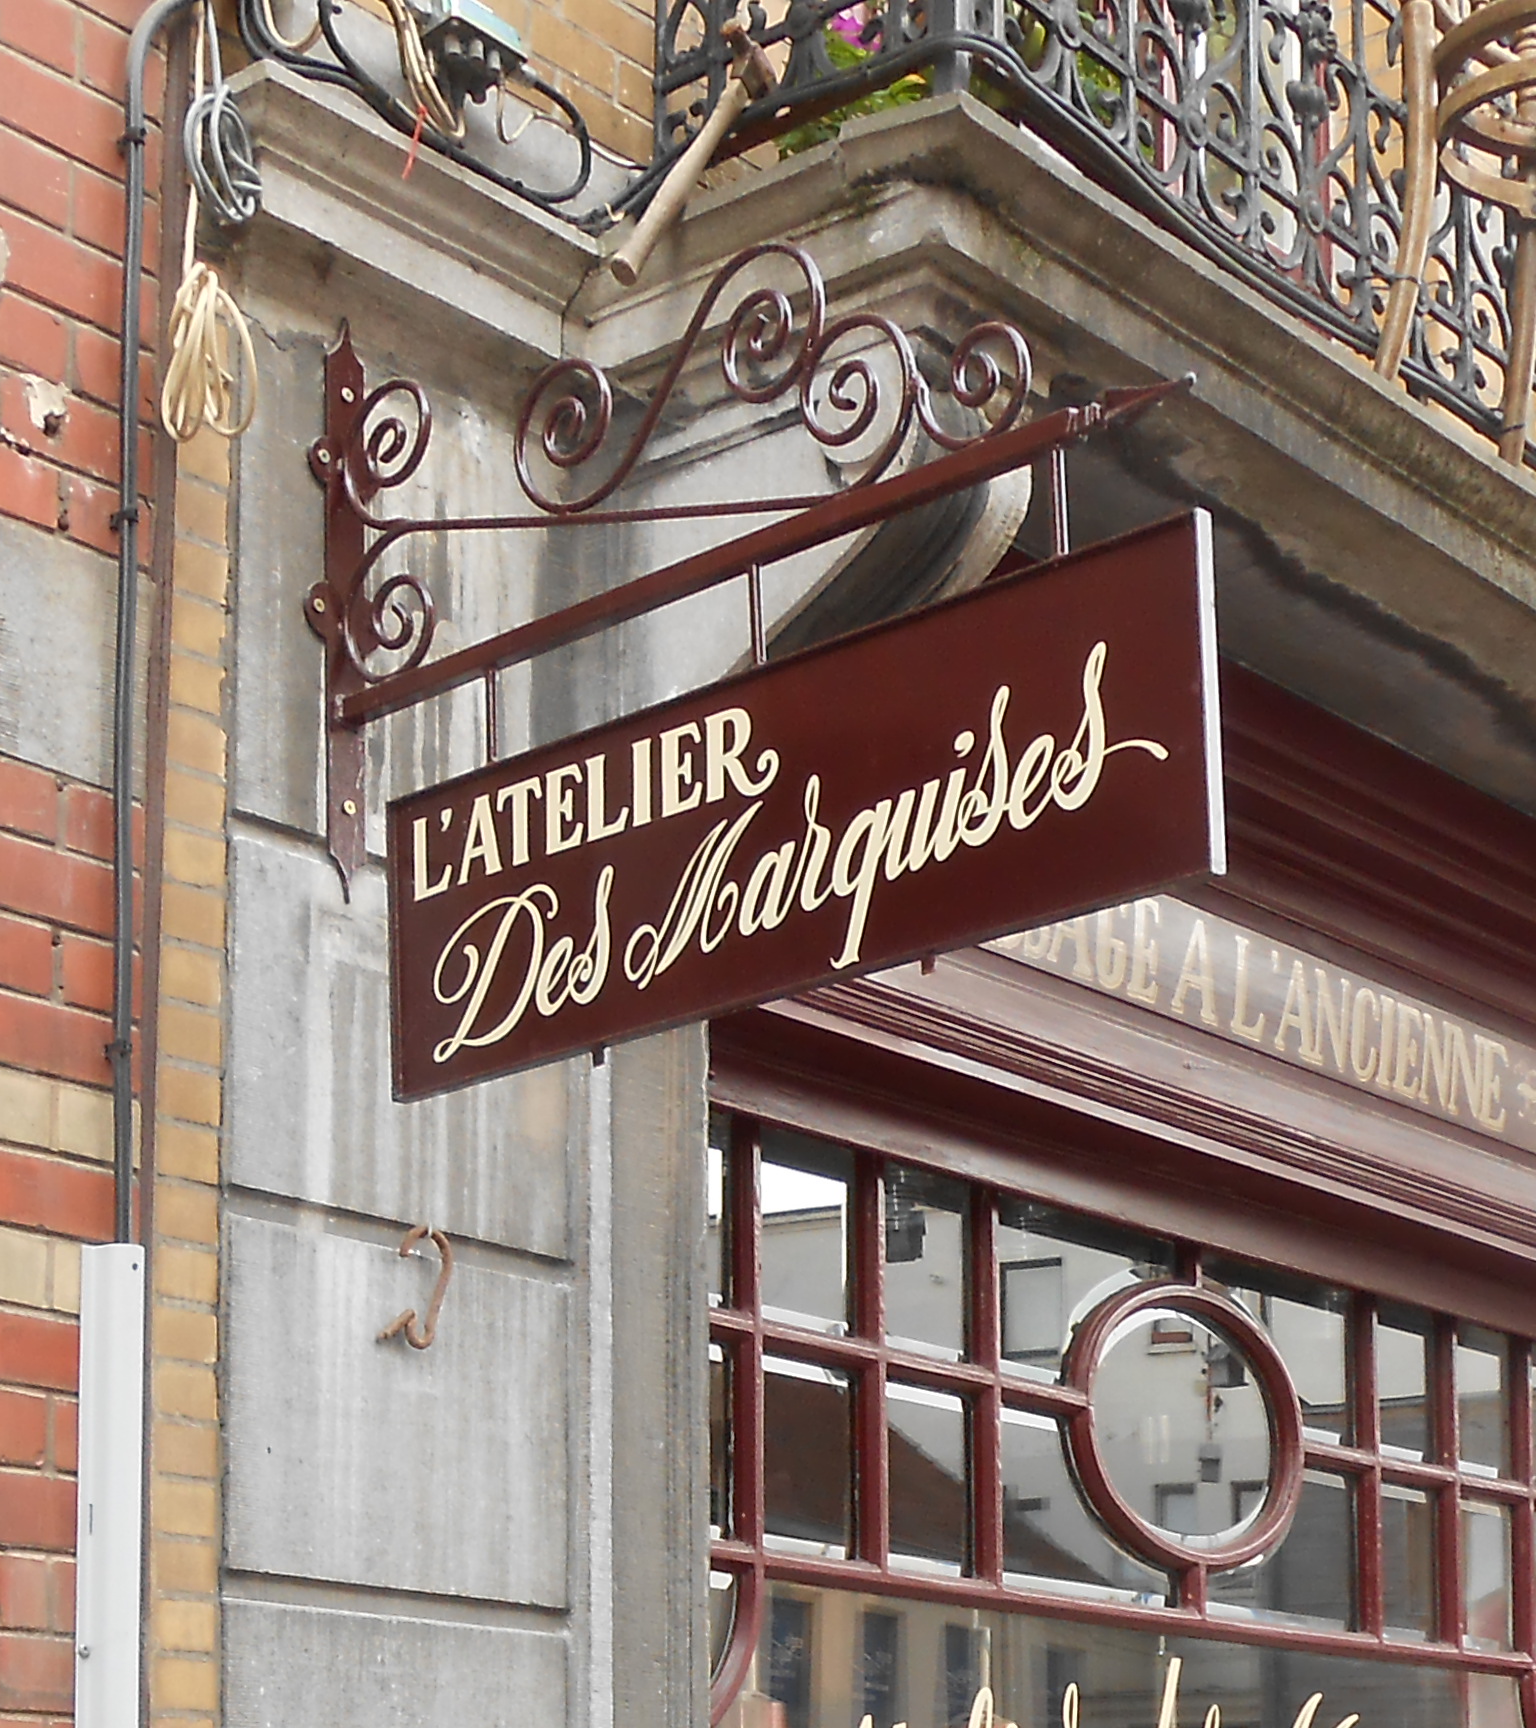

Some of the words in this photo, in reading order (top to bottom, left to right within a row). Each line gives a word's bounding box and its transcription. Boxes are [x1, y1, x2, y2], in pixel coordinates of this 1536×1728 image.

[413, 707, 780, 902] L'ATELIER
[433, 864, 615, 1064] Des
[623, 640, 1169, 991] Marquises
[1230, 934, 1510, 1133] L'ANCIENNE
